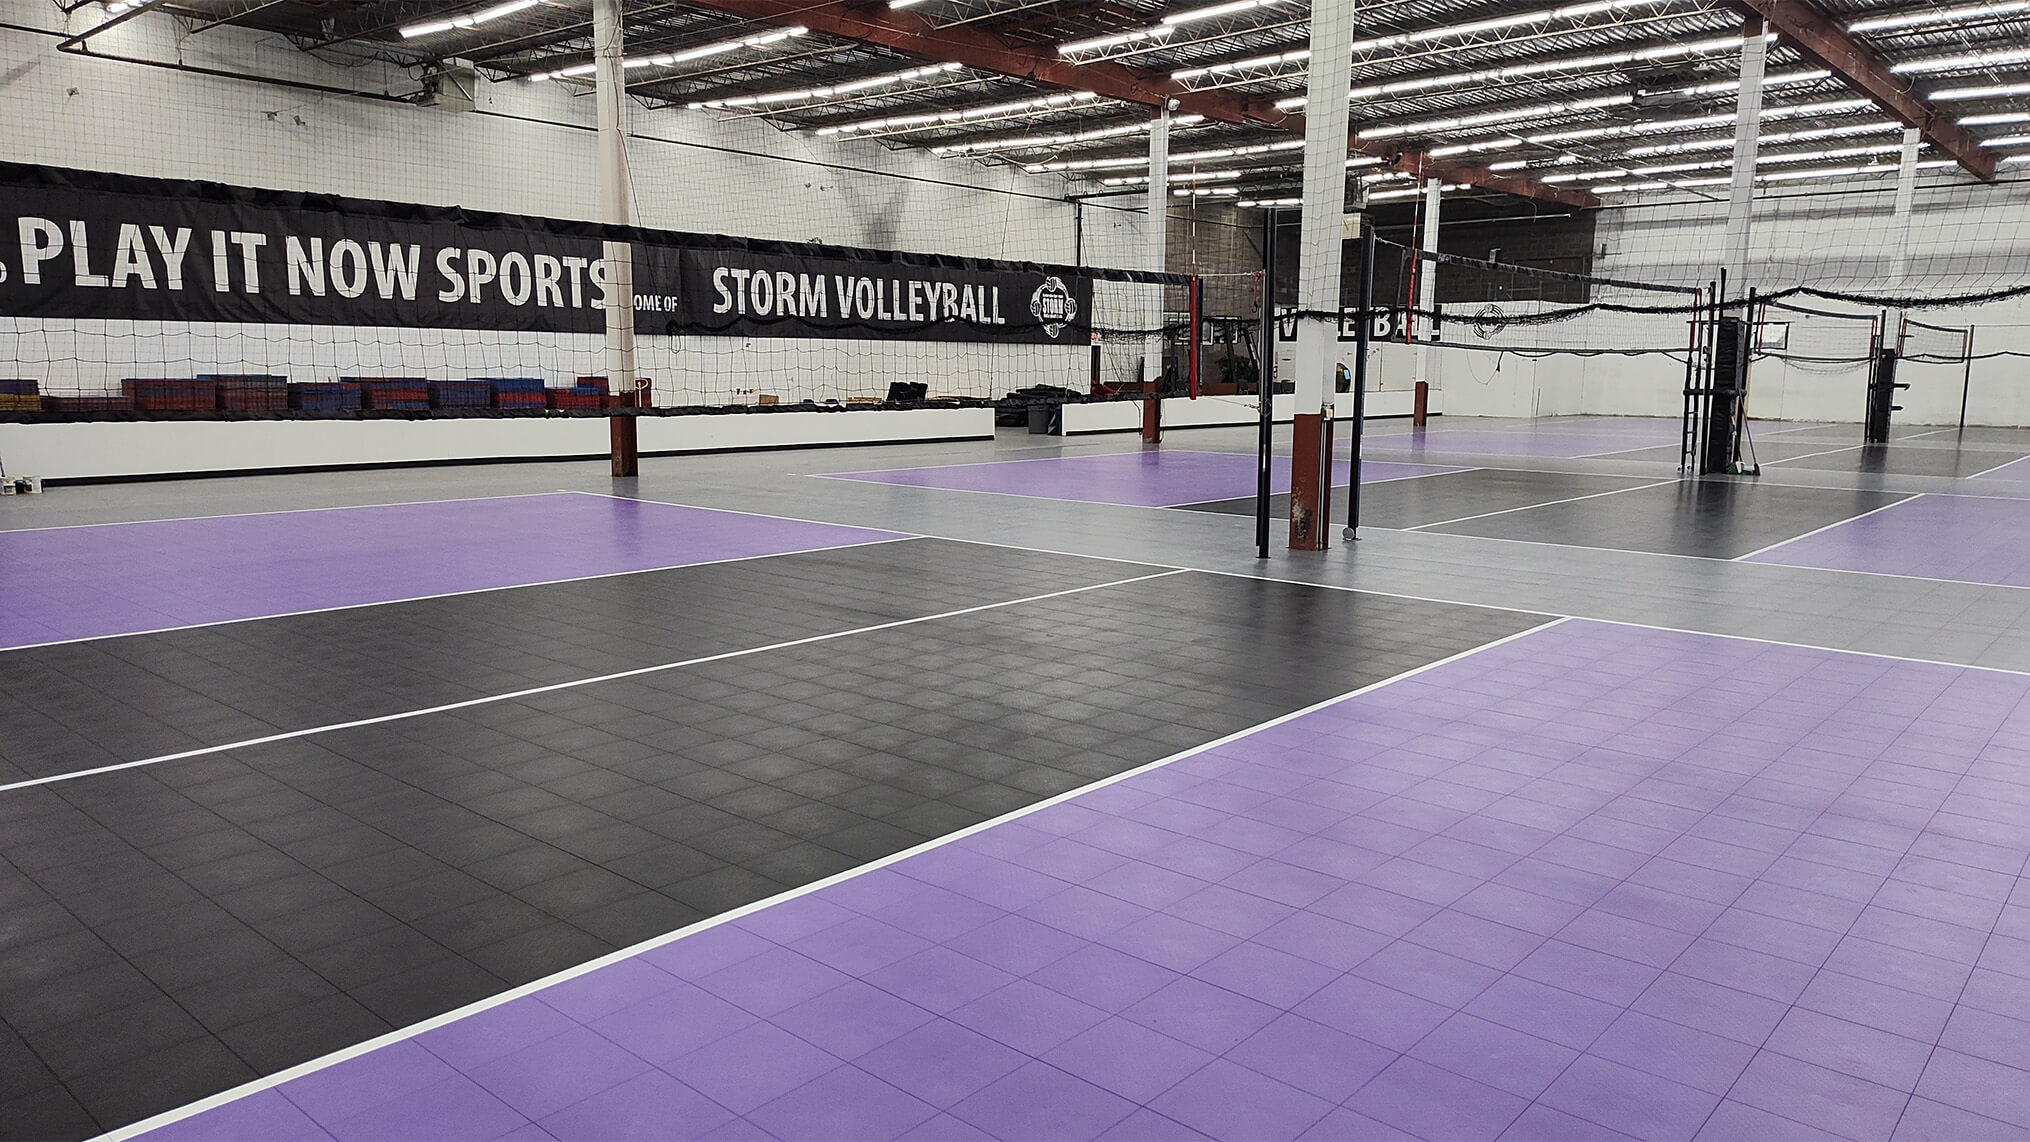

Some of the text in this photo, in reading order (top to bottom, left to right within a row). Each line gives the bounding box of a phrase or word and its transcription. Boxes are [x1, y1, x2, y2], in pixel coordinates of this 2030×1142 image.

[18, 216, 607, 310] PLAY IT NOW SPORTS
[633, 294, 678, 312] OME OF
[713, 266, 1006, 325] STORM VOLLEYBALL
